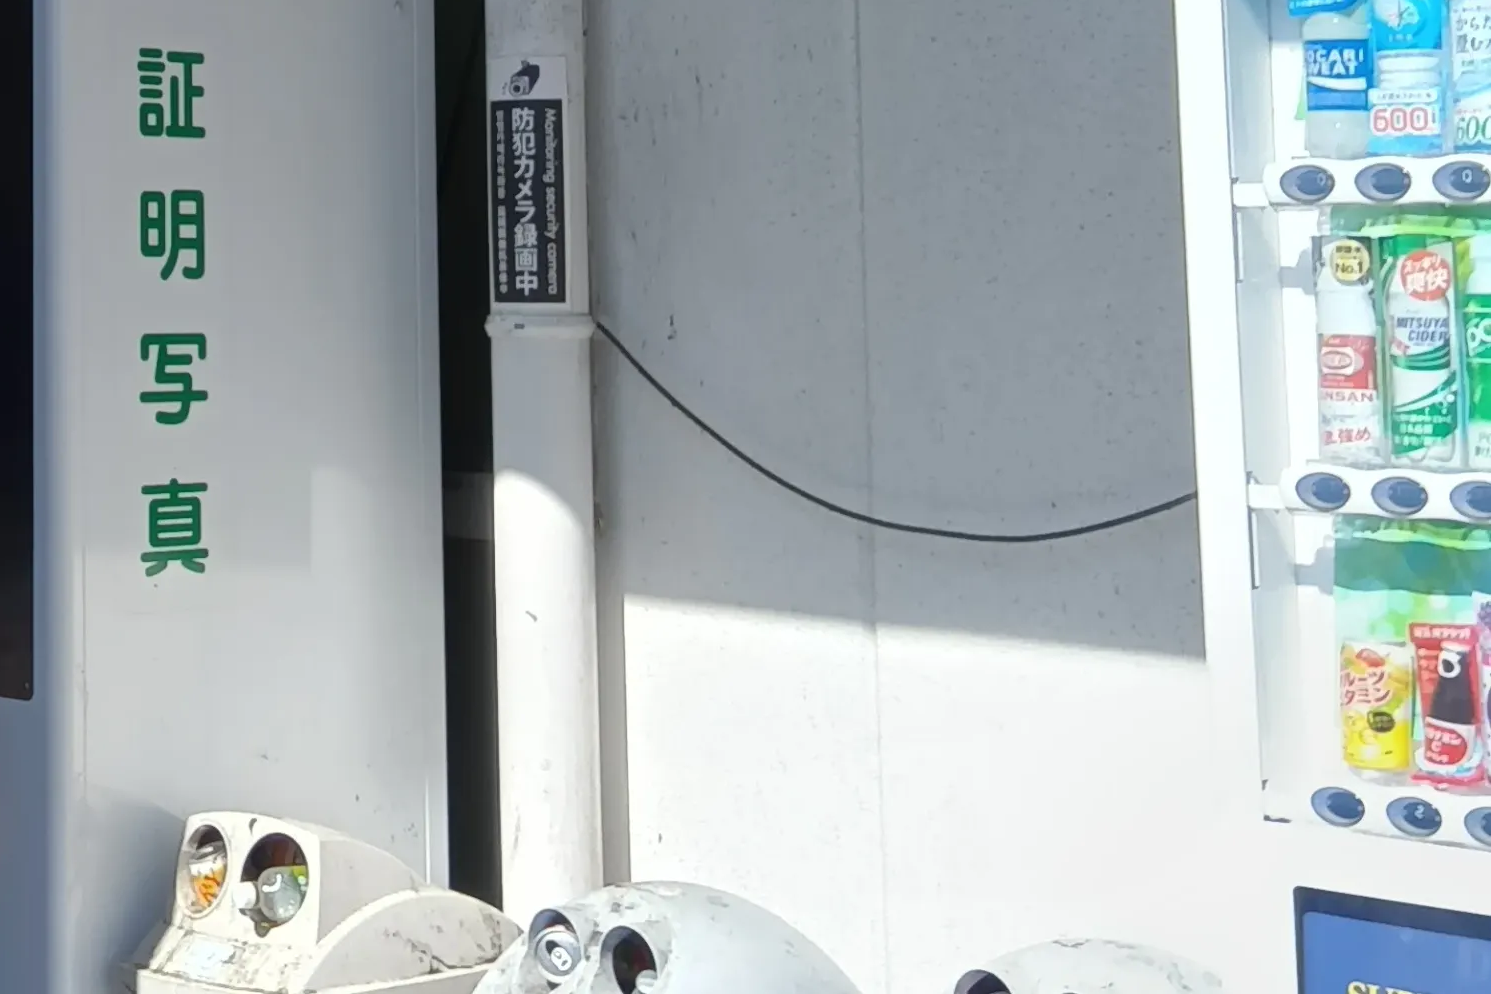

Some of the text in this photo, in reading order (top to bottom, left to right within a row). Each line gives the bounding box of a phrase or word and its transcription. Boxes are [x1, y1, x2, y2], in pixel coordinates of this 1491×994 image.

[1373, 107, 1429, 133] 600
[511, 106, 539, 296] 防犯カメラ録画中
[543, 108, 559, 295] Monitoring security camera
[1335, 262, 1363, 275] No.1
[137, 47, 209, 577] 証明写真
[1396, 316, 1450, 330] MITSUYA
[1407, 329, 1450, 343] CIDER
[1340, 669, 1386, 687] ルーツ
[1340, 688, 1391, 706] タミン
